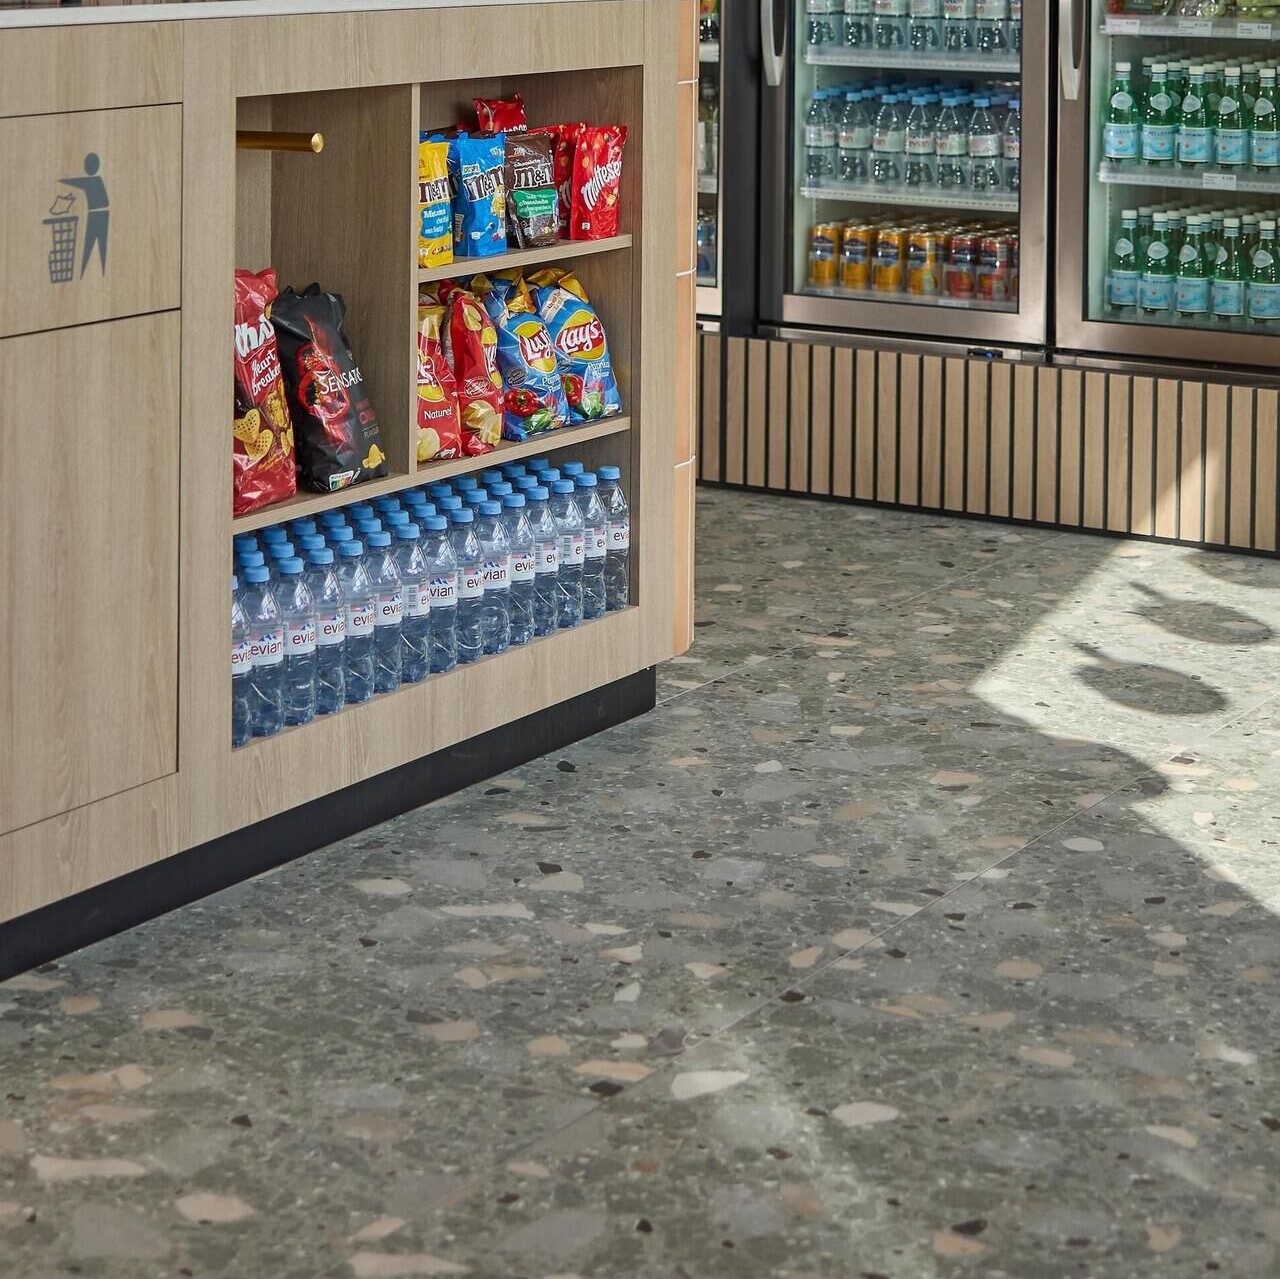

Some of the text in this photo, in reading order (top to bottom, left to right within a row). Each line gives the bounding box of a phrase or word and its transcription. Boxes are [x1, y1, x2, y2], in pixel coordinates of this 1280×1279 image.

[560, 320, 599, 353] Lay's
[424, 406, 452, 420] Naturel
[515, 560, 535, 572] evia
[484, 569, 506, 580] vian
[430, 585, 454, 598] vian
[382, 602, 402, 615] evia
[353, 612, 374, 626] evia
[323, 621, 345, 635] evia
[292, 631, 314, 644] evia
[232, 649, 251, 664] evia
